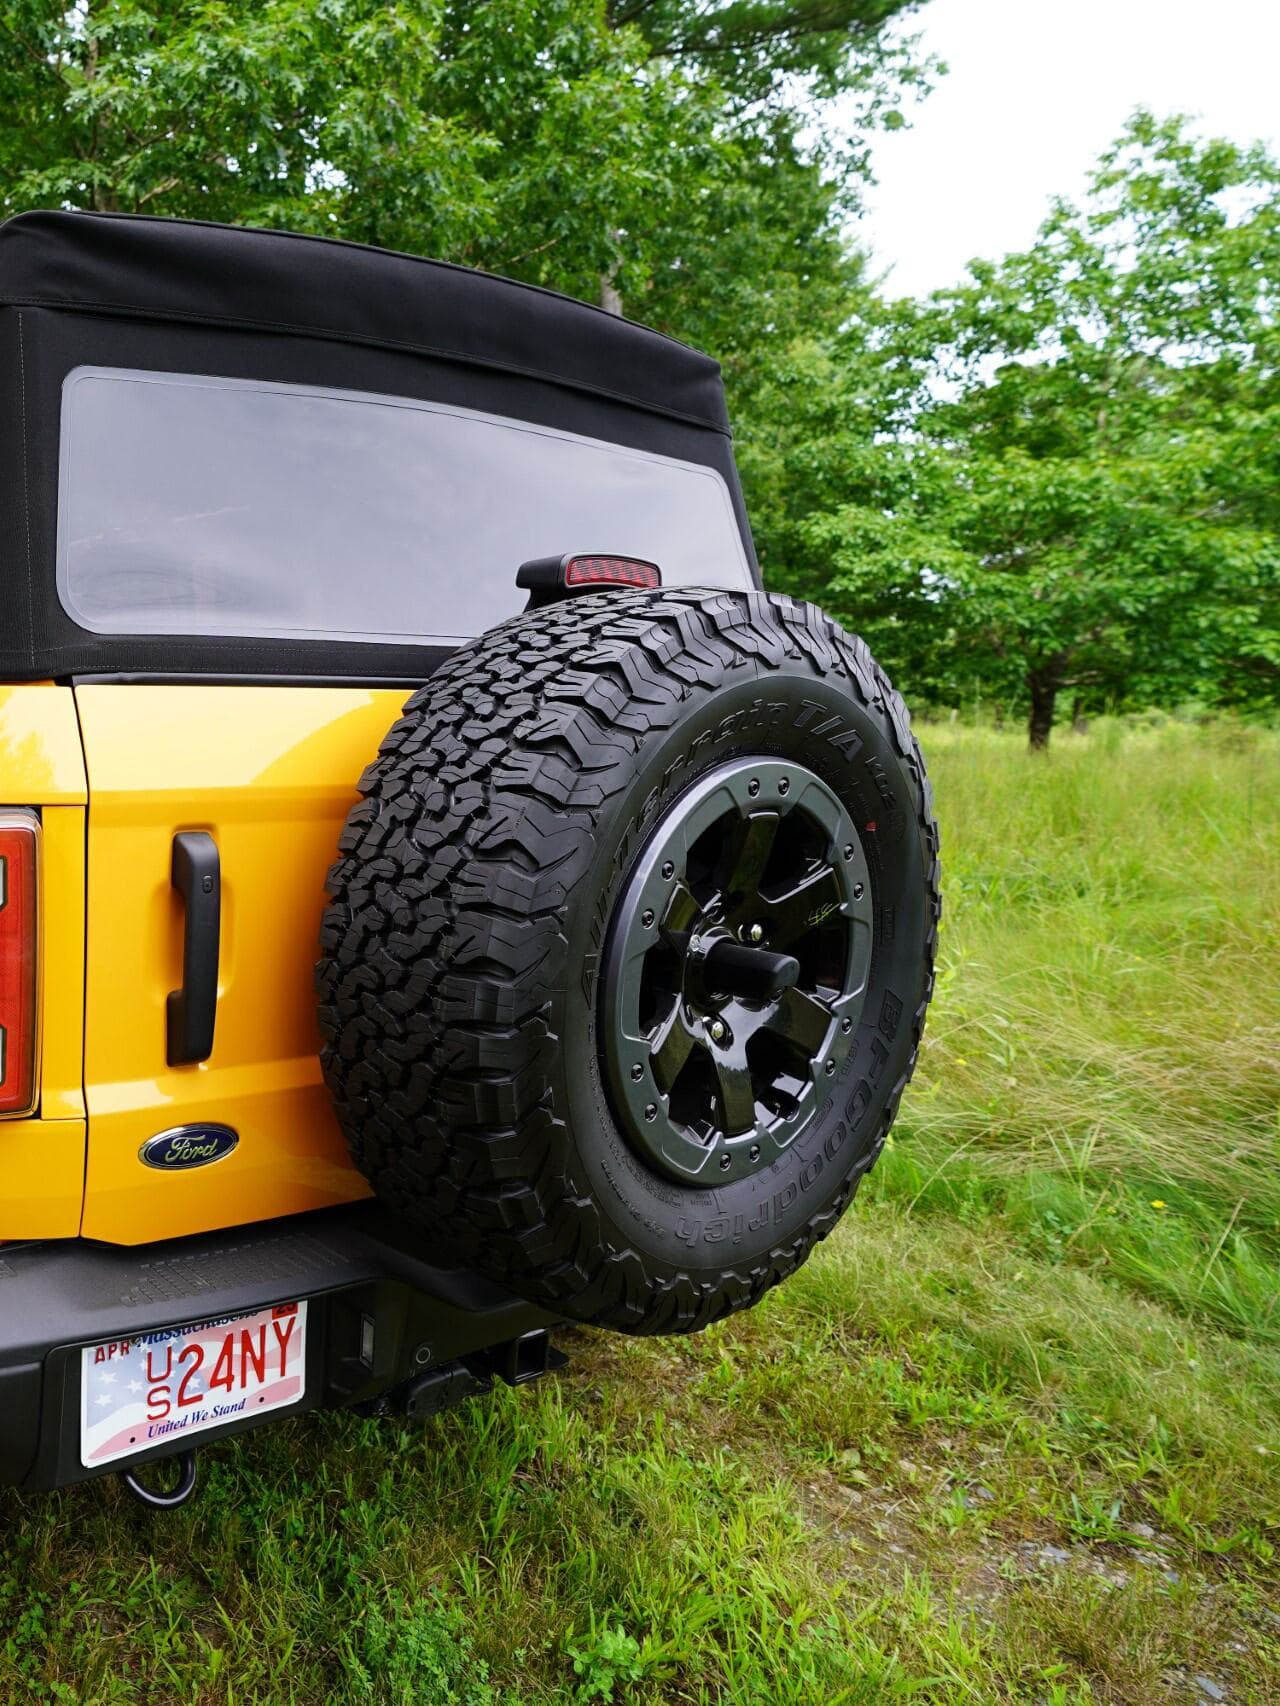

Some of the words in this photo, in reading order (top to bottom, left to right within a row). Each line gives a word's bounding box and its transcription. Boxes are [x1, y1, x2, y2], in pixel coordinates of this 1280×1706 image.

[675, 988, 904, 1247] BFGoodrich
[165, 1134, 218, 1163] Ford
[94, 1341, 130, 1364] APR
[149, 1415, 188, 1438] United
[192, 1410, 209, 1424] We
[211, 1398, 246, 1418] Stand
